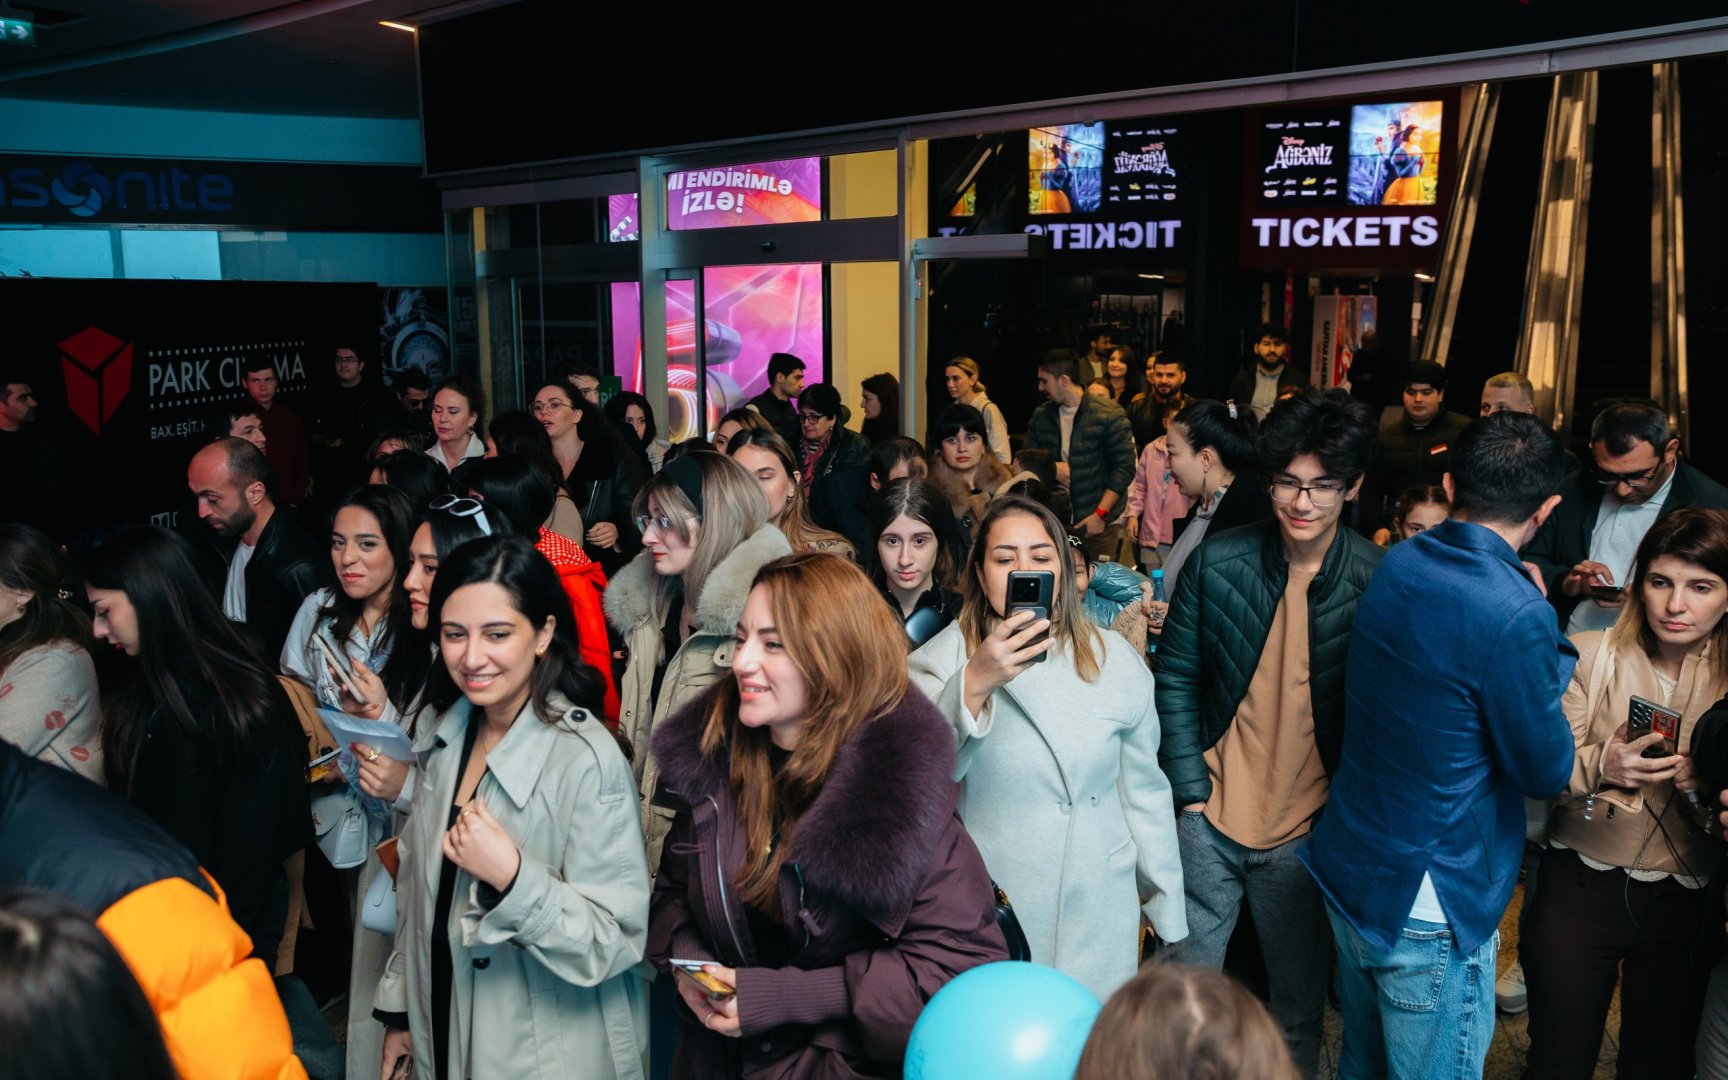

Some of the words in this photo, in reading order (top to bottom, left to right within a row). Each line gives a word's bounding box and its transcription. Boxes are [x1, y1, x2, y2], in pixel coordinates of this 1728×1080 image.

[687, 167, 793, 196] ENDİRİMLƏ
[681, 189, 745, 217] İZLƏ!
[1251, 215, 1439, 248] TICKETS
[148, 359, 212, 397] PARK
[218, 351, 307, 389] CIMA
